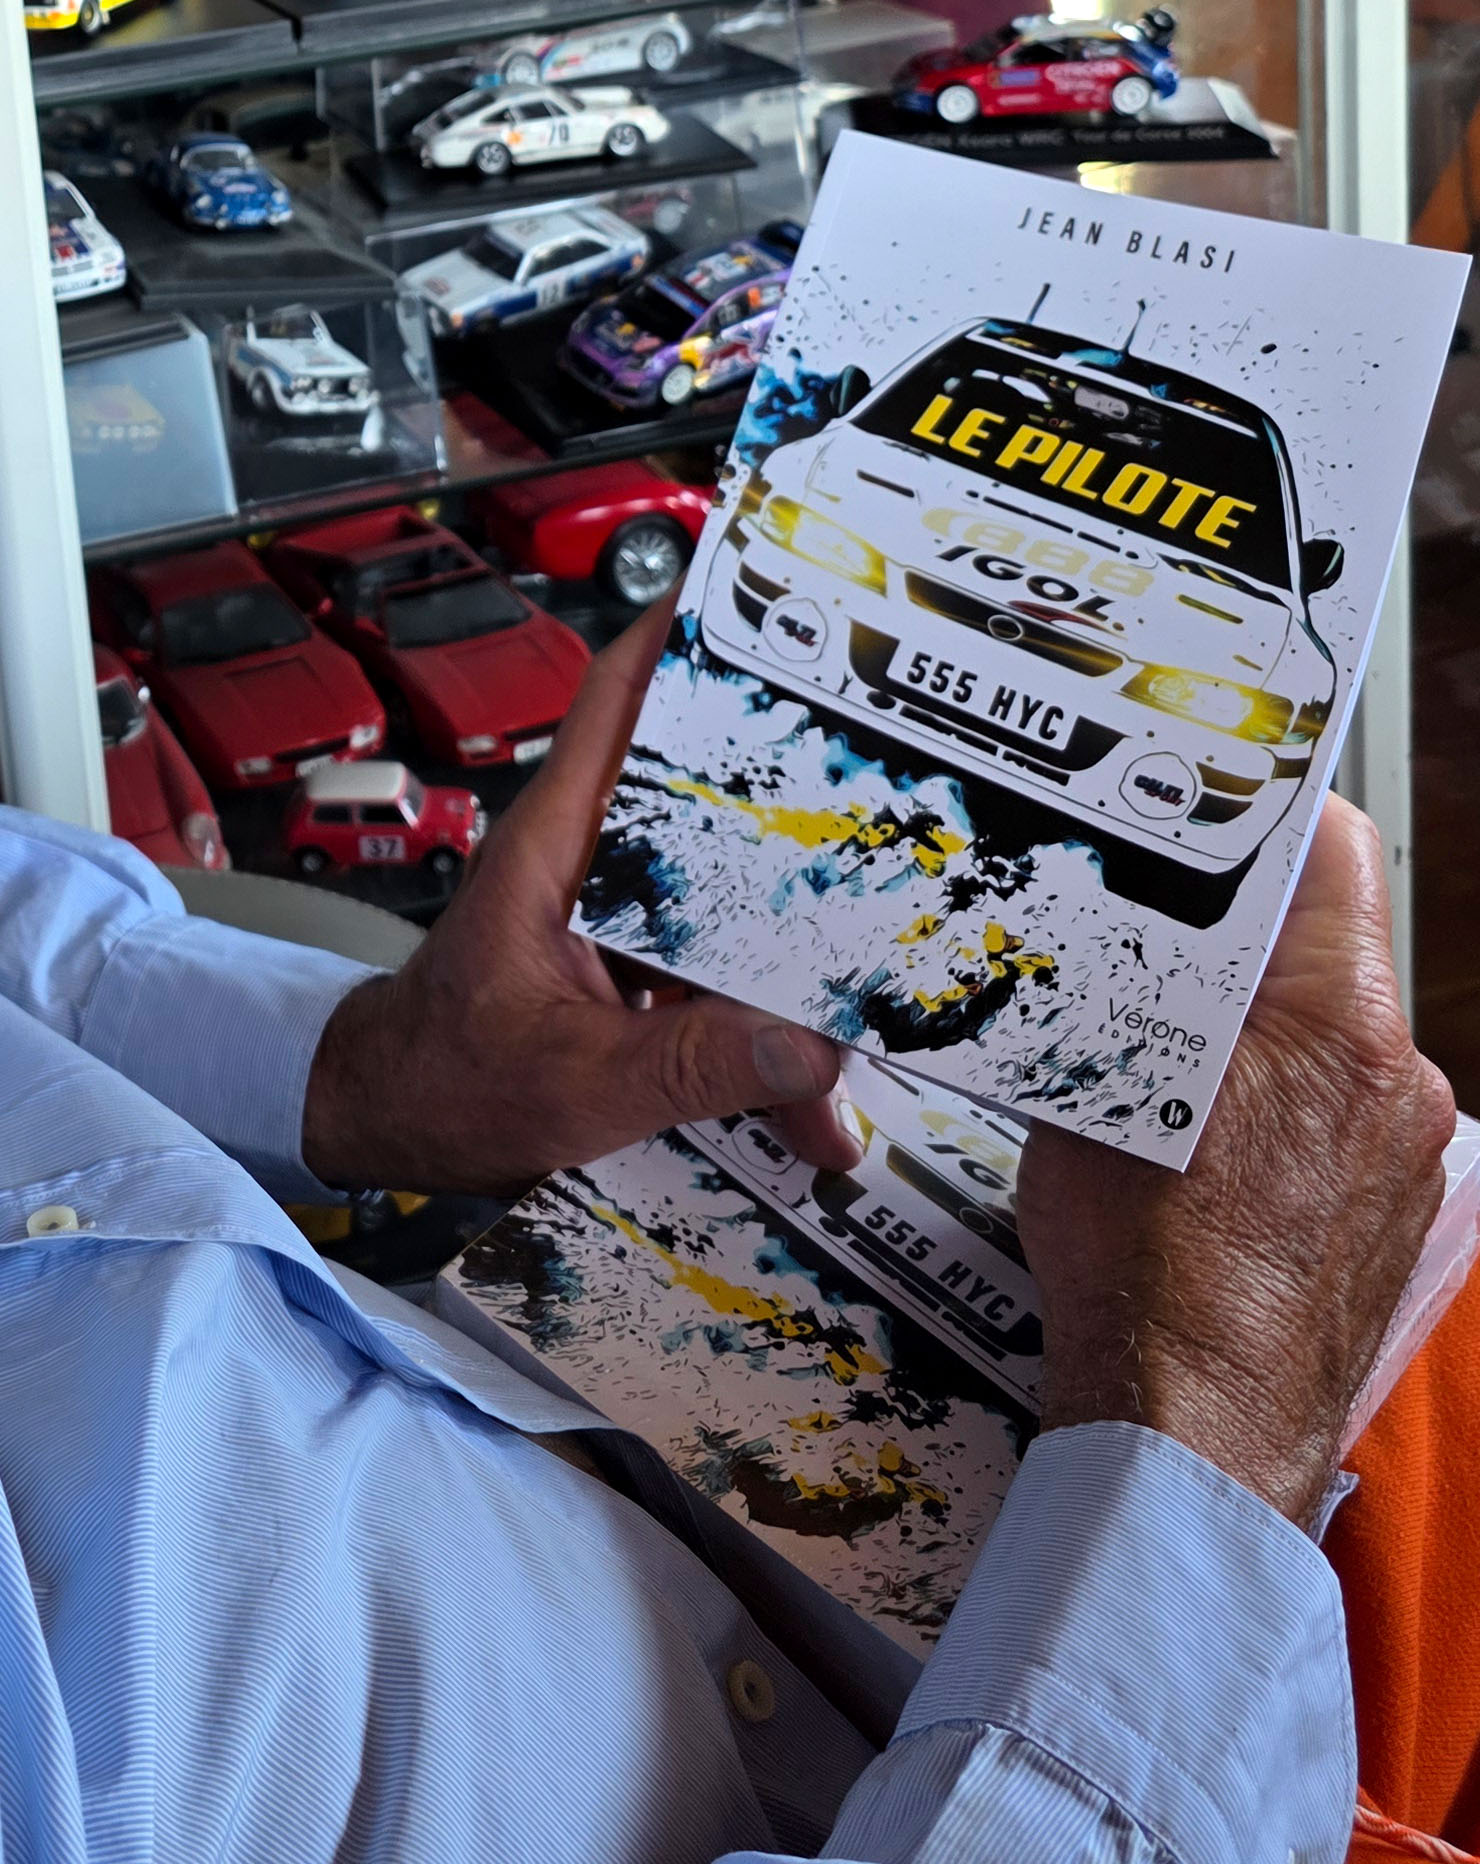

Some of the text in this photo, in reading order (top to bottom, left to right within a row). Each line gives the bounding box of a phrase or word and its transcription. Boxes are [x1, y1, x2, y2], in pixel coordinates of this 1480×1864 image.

[1017, 207, 1236, 273] JEAN BLASI
[910, 393, 1258, 549] LE PILOTE
[935, 545, 1117, 622] IGOL
[906, 651, 1065, 741] 555 HYC
[864, 1204, 1016, 1322] 555 HYC
